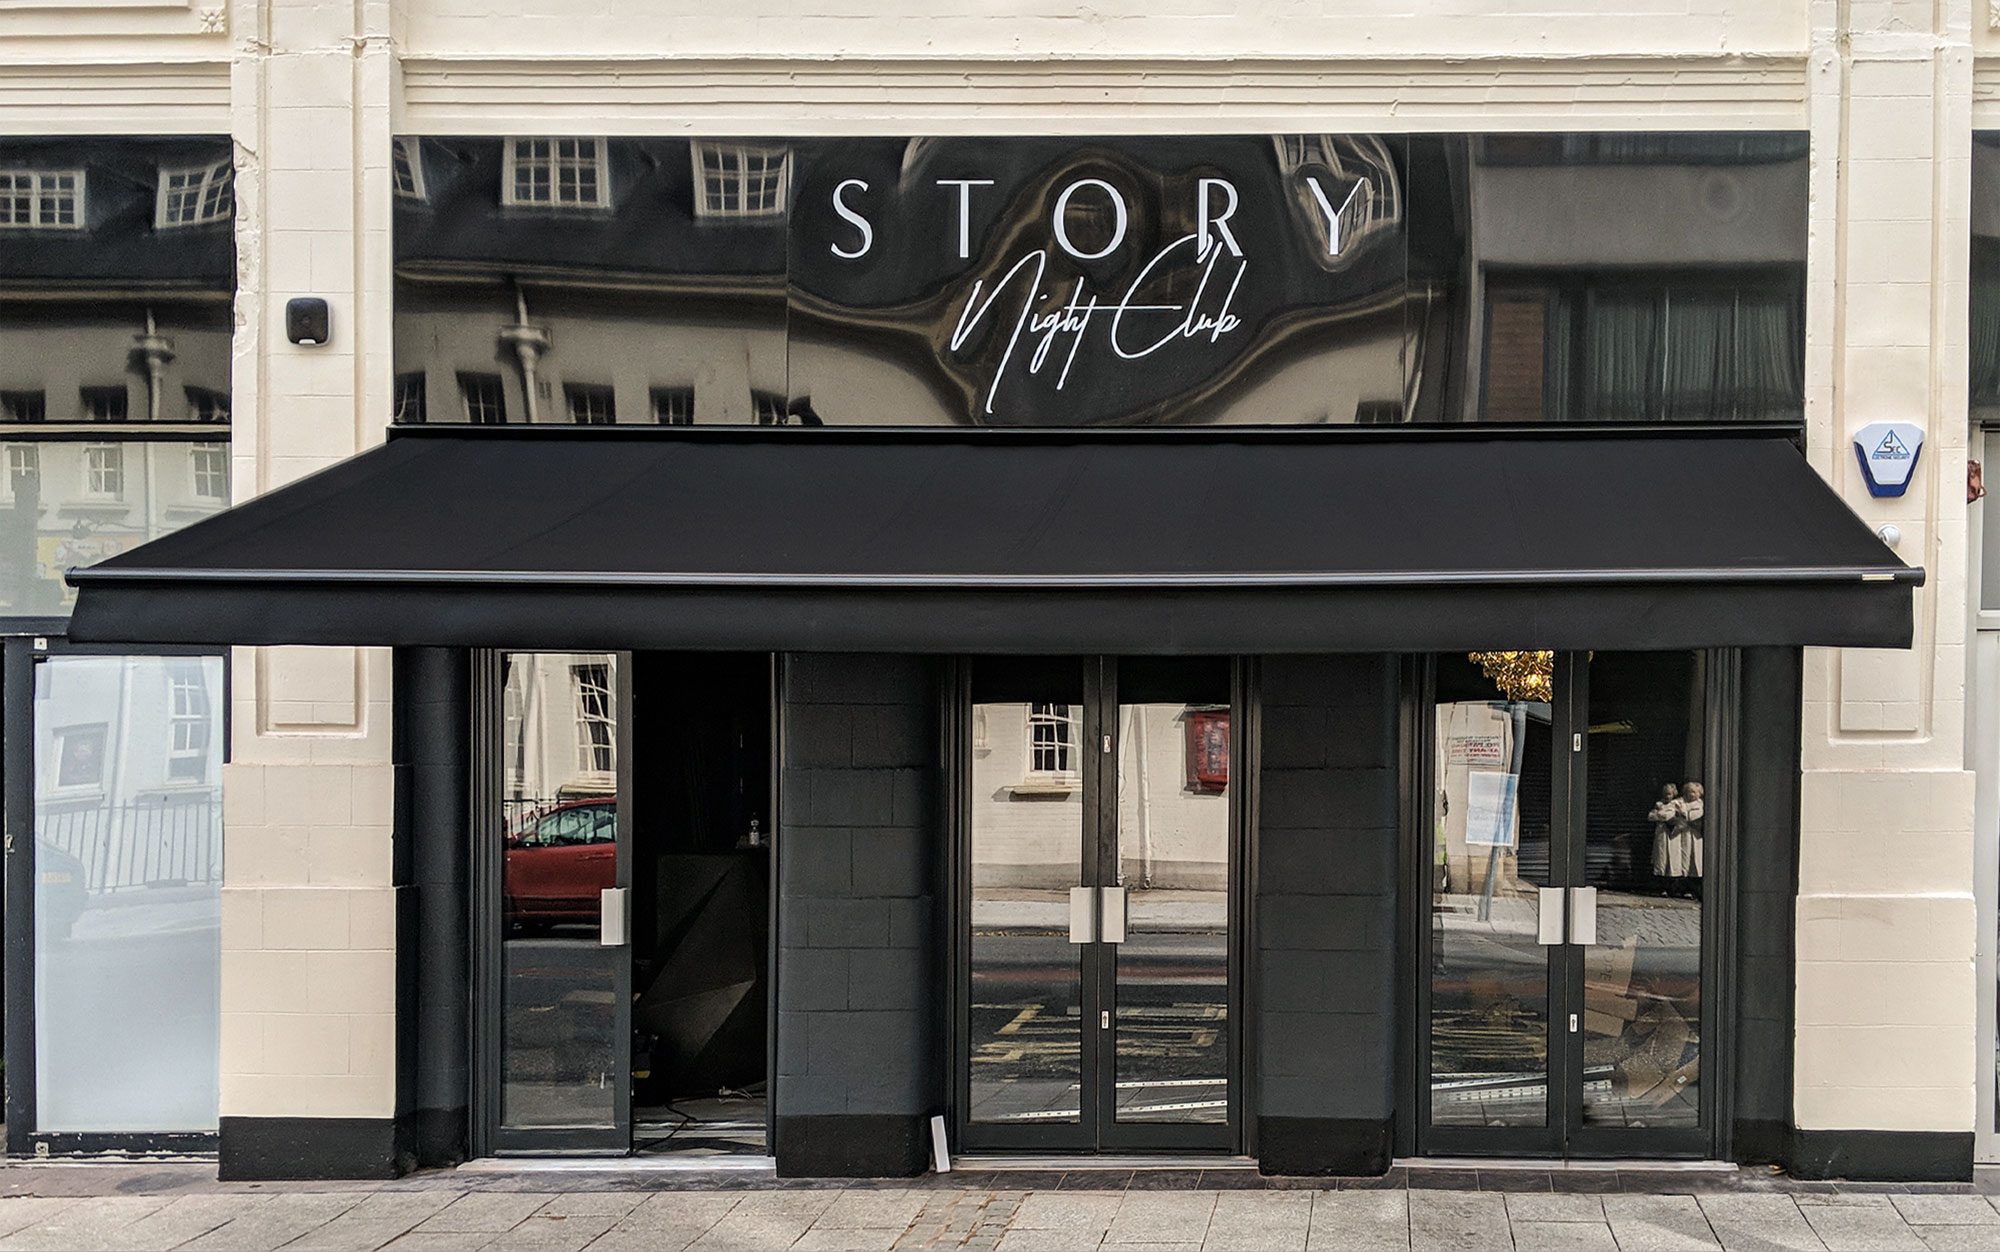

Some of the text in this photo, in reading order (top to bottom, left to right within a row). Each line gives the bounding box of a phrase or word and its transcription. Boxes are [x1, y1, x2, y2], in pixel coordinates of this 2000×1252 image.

[830, 178, 1366, 259] STORY
[949, 233, 1248, 415] Night Club
